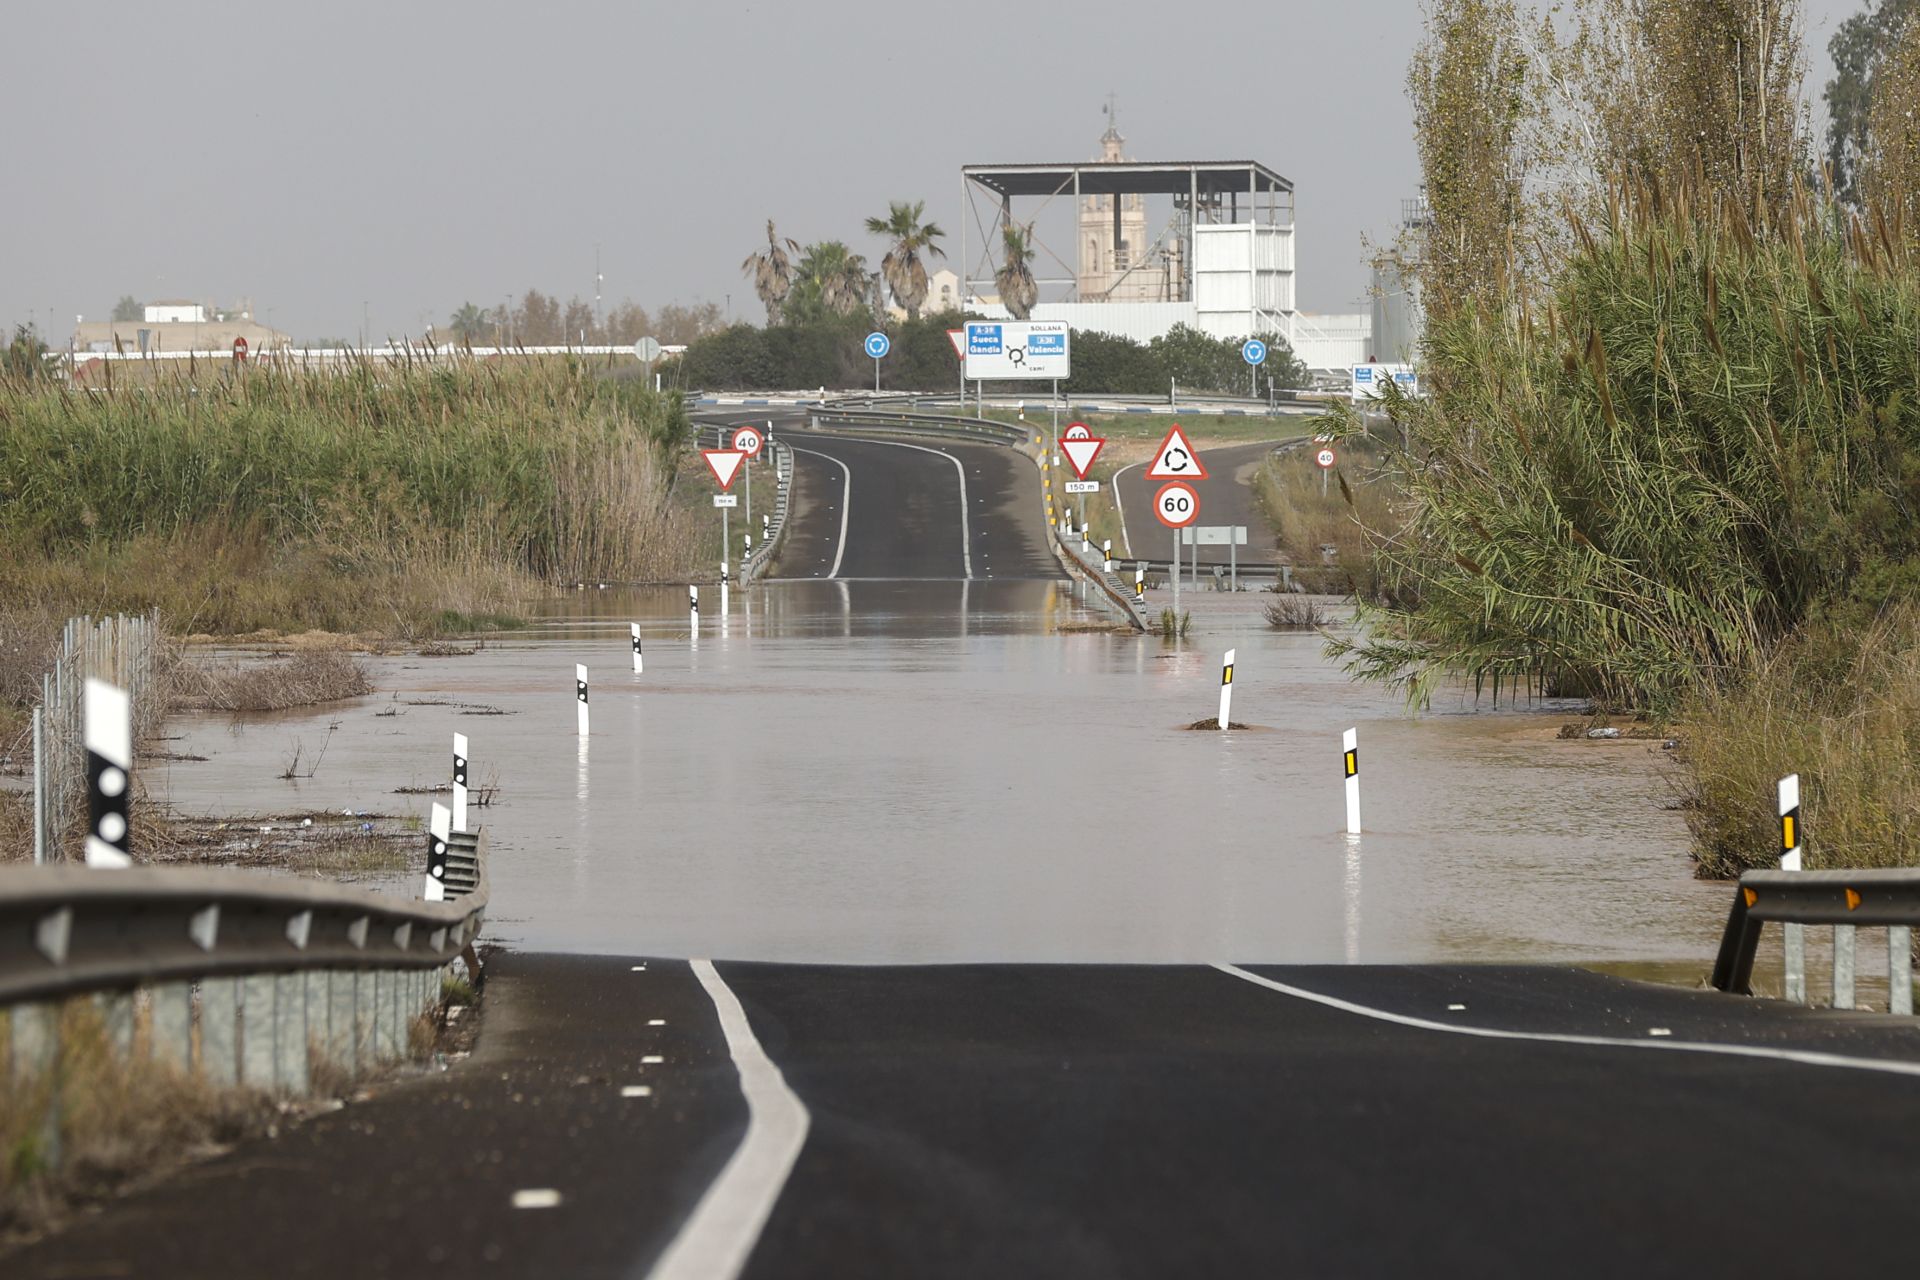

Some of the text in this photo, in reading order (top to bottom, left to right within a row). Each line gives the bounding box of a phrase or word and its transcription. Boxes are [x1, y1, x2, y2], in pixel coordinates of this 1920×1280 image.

[972, 335, 999, 343] Sueca
[1029, 345, 1064, 353] Valencia
[738, 438, 756, 448] 40
[1164, 497, 1189, 512] 60
